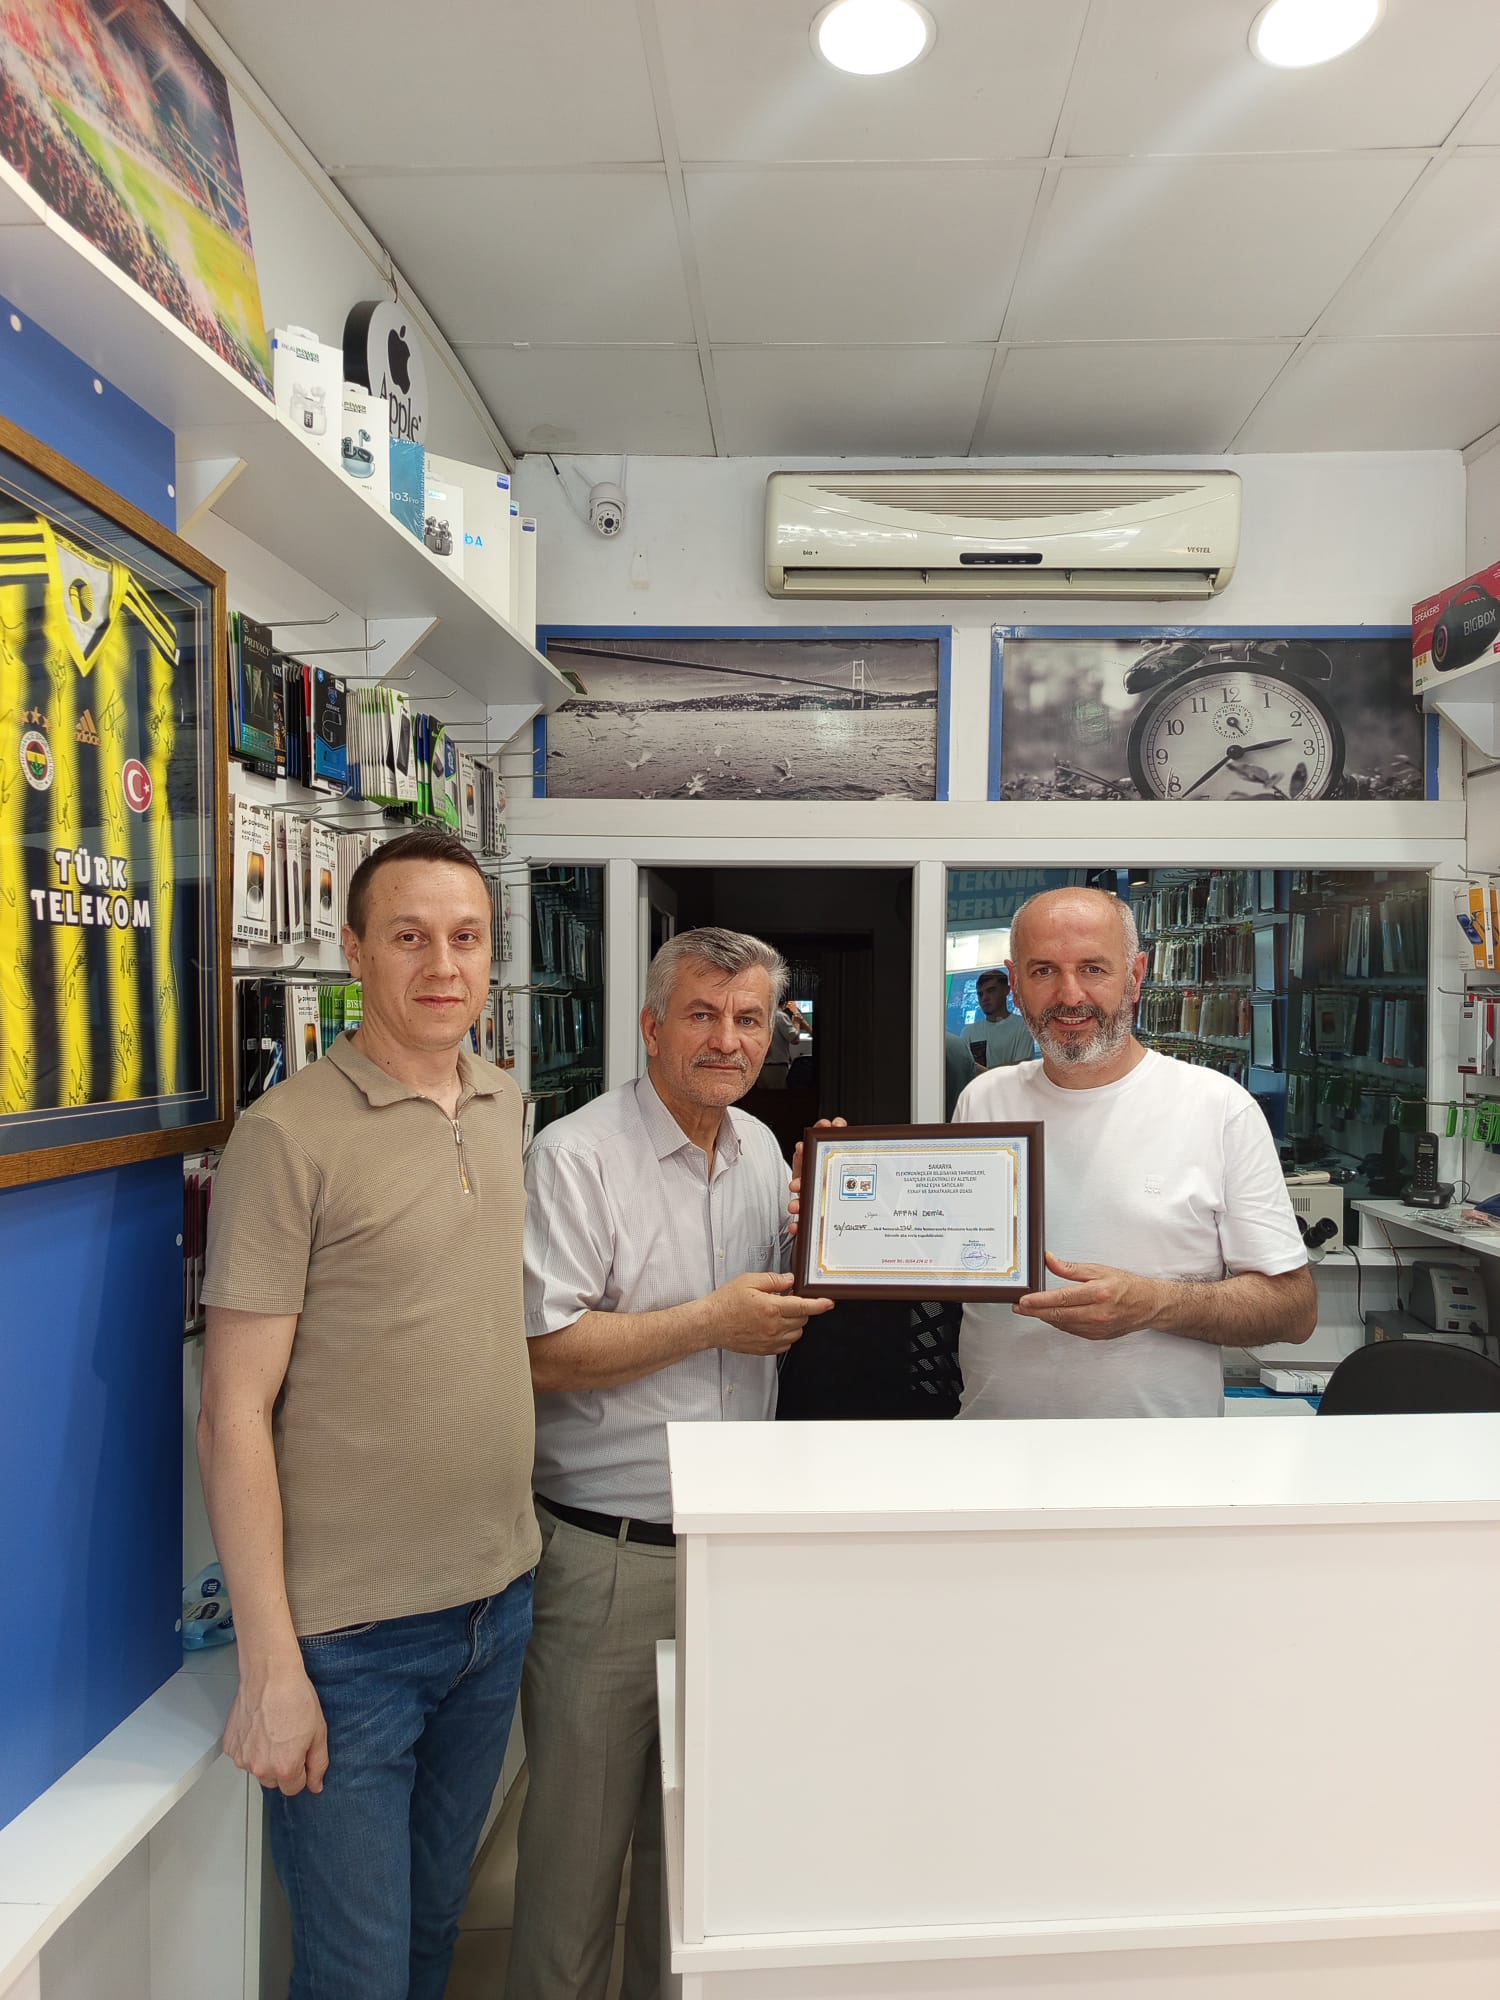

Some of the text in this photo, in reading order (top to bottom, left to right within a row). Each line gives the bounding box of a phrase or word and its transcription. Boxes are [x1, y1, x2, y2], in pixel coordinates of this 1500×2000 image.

[379, 371, 420, 443] Apple
[390, 490, 409, 502] no3
[1186, 546, 1211, 554] VESTEL
[1414, 604, 1440, 625] SPEAKERS
[1463, 608, 1496, 637] BIGBOX
[244, 634, 271, 657] PRIVACY
[1221, 687, 1242, 704] 12
[1263, 692, 1271, 709] 1
[1191, 696, 1208, 713] 11
[1289, 710, 1302, 727] 2
[1166, 719, 1184, 736] 10
[1303, 739, 1315, 756] 3
[1156, 749, 1168, 765] 9
[1169, 775, 1182, 793] 8
[55, 848, 127, 889] TÜRK
[30, 889, 151, 928] TELEKOM
[947, 891, 1025, 920] SERVİ
